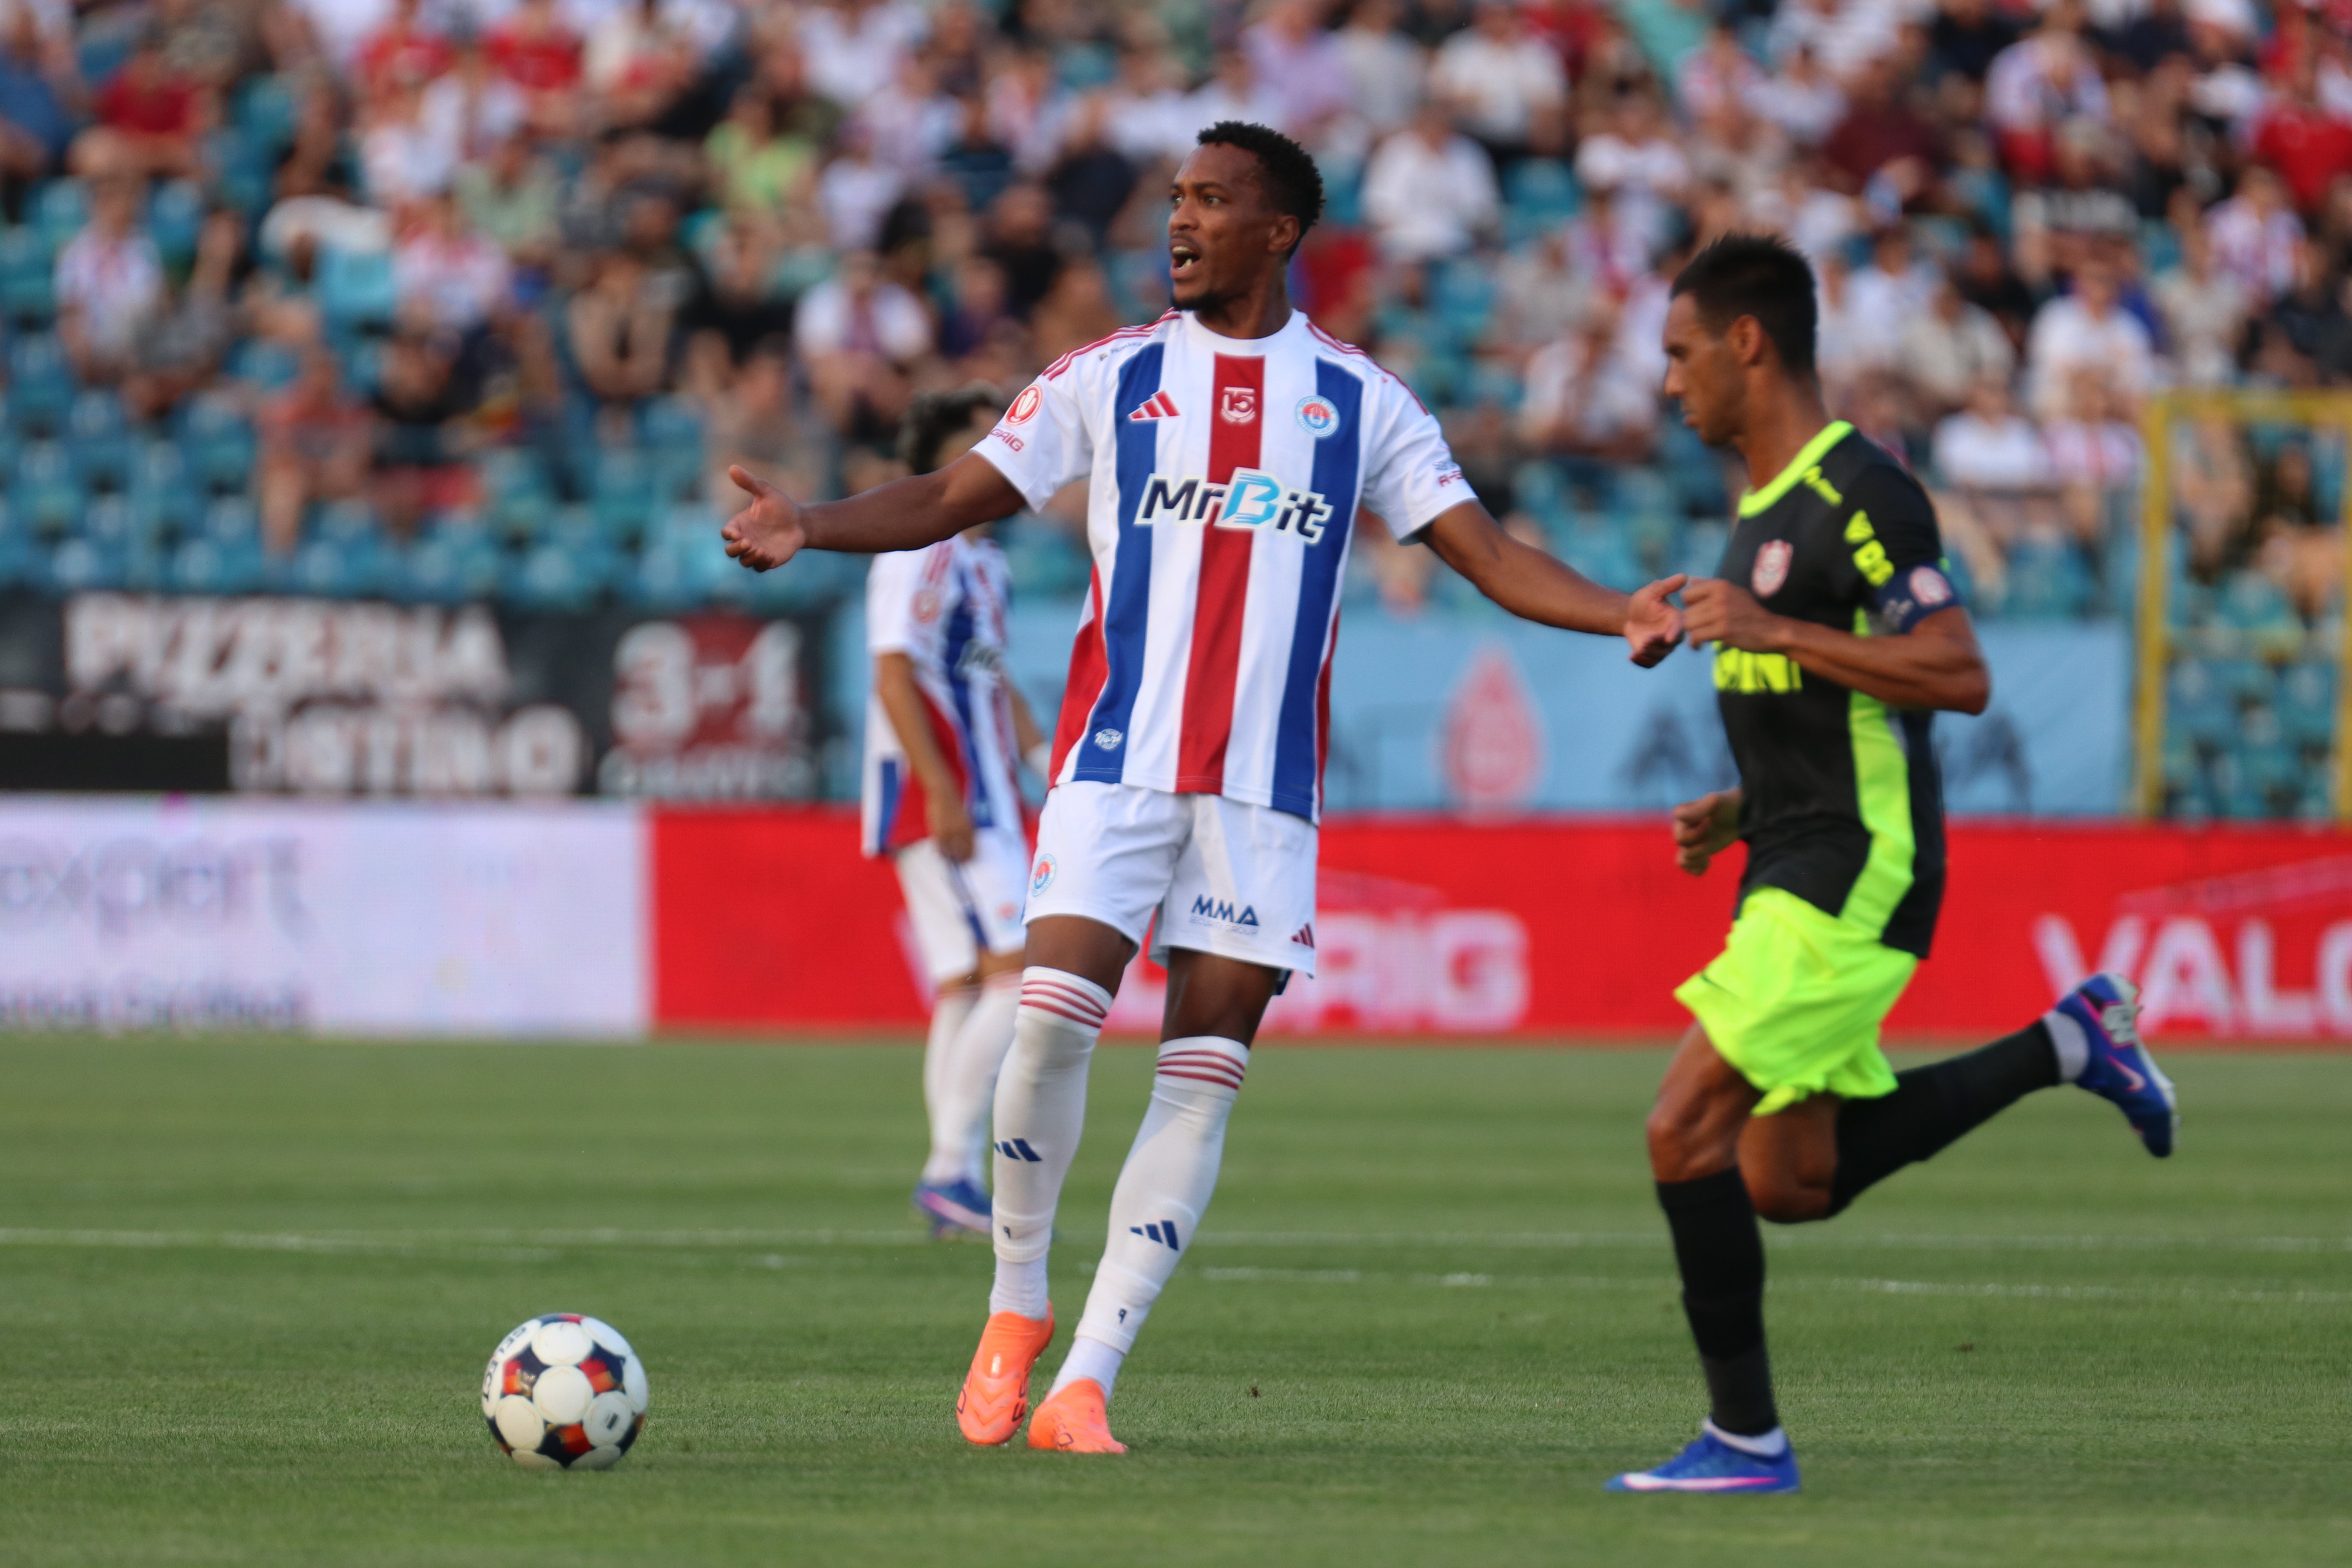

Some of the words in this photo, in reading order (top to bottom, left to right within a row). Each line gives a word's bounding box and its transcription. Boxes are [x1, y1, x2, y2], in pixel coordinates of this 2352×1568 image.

[1141, 472, 1327, 539] MrBit
[1191, 893, 1260, 927] MMA
[1118, 1308, 1127, 1323] 9
